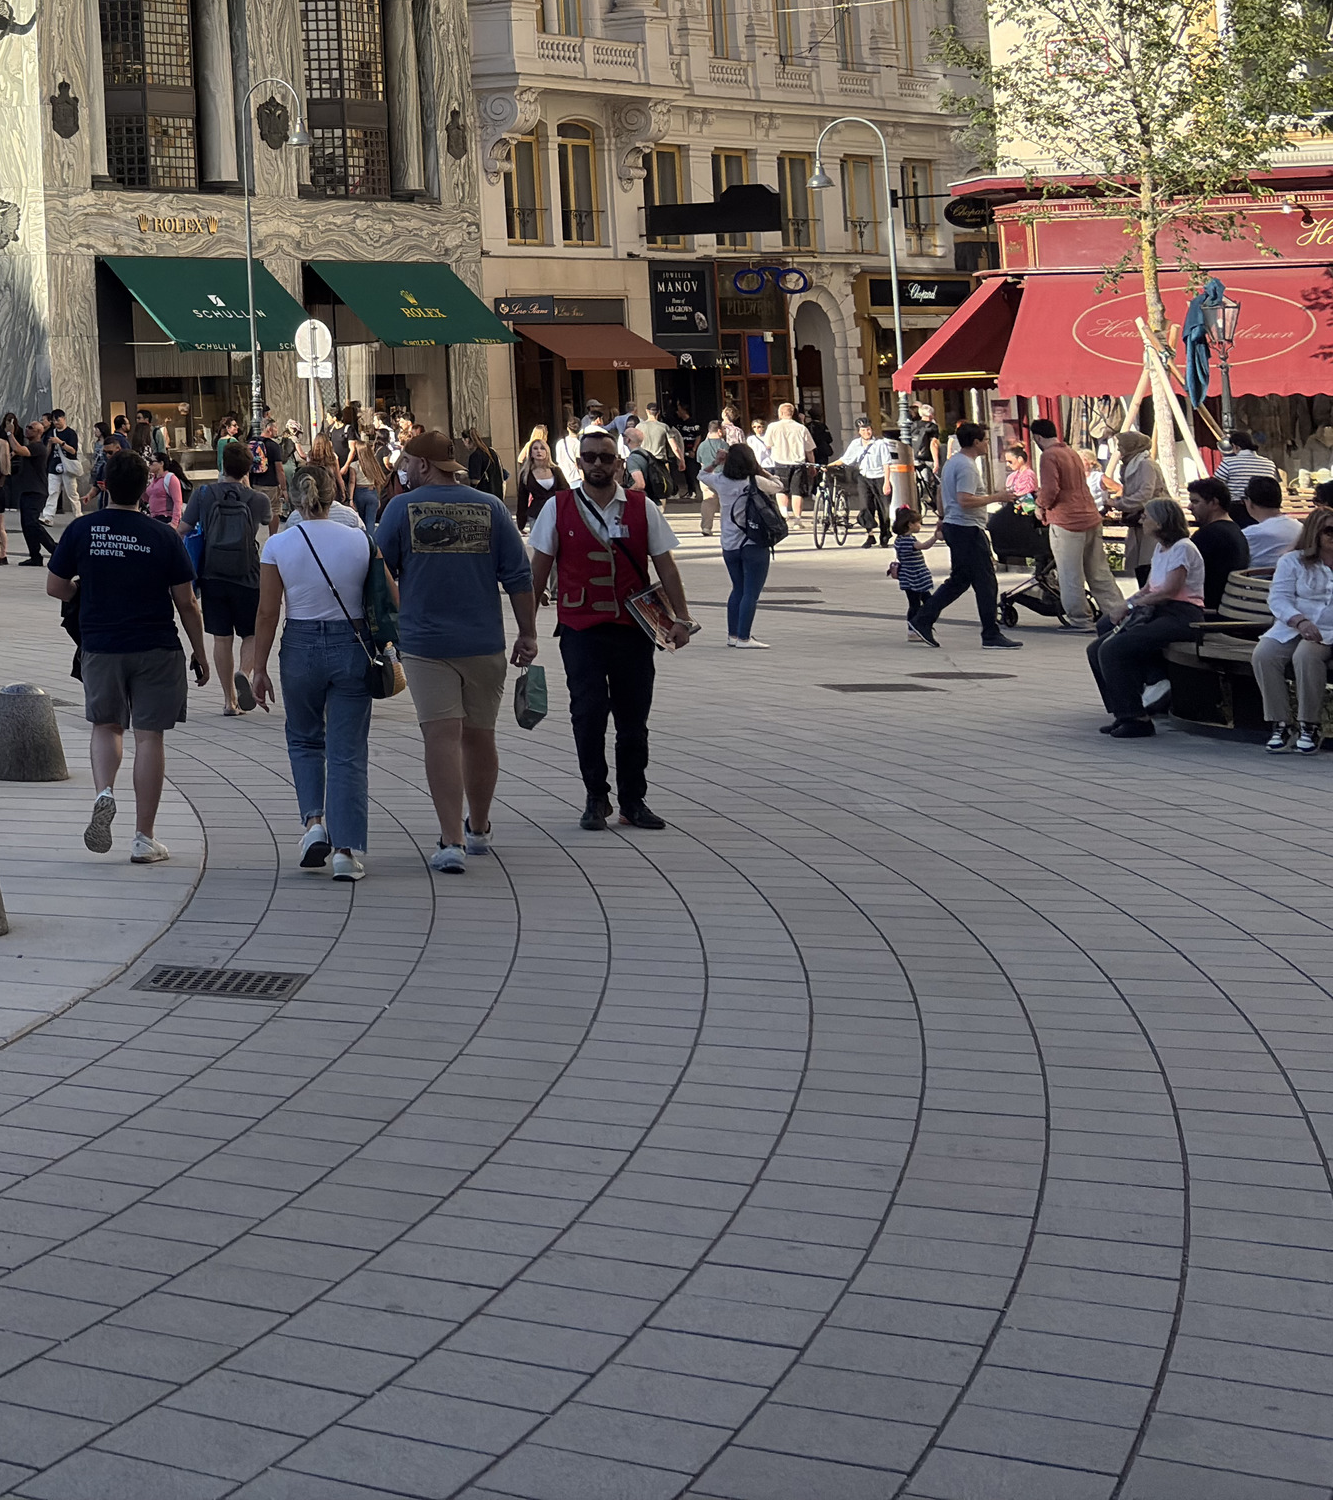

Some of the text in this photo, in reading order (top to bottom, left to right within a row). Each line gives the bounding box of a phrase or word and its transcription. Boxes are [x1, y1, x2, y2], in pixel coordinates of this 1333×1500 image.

[154, 217, 204, 234] ROLEX
[657, 280, 698, 293] MANOV
[192, 309, 267, 319] SCHULLN
[400, 307, 448, 318] ROLEX
[1086, 318, 1141, 339] Hous
[194, 342, 237, 350] SCHULLIN
[423, 507, 488, 517] COWBOY BAR
[90, 525, 111, 533] KEEP
[90, 533, 138, 543] THE WORLD
[90, 541, 151, 554] ADVENTUROUS
[89, 548, 126, 558] FOREVER.
